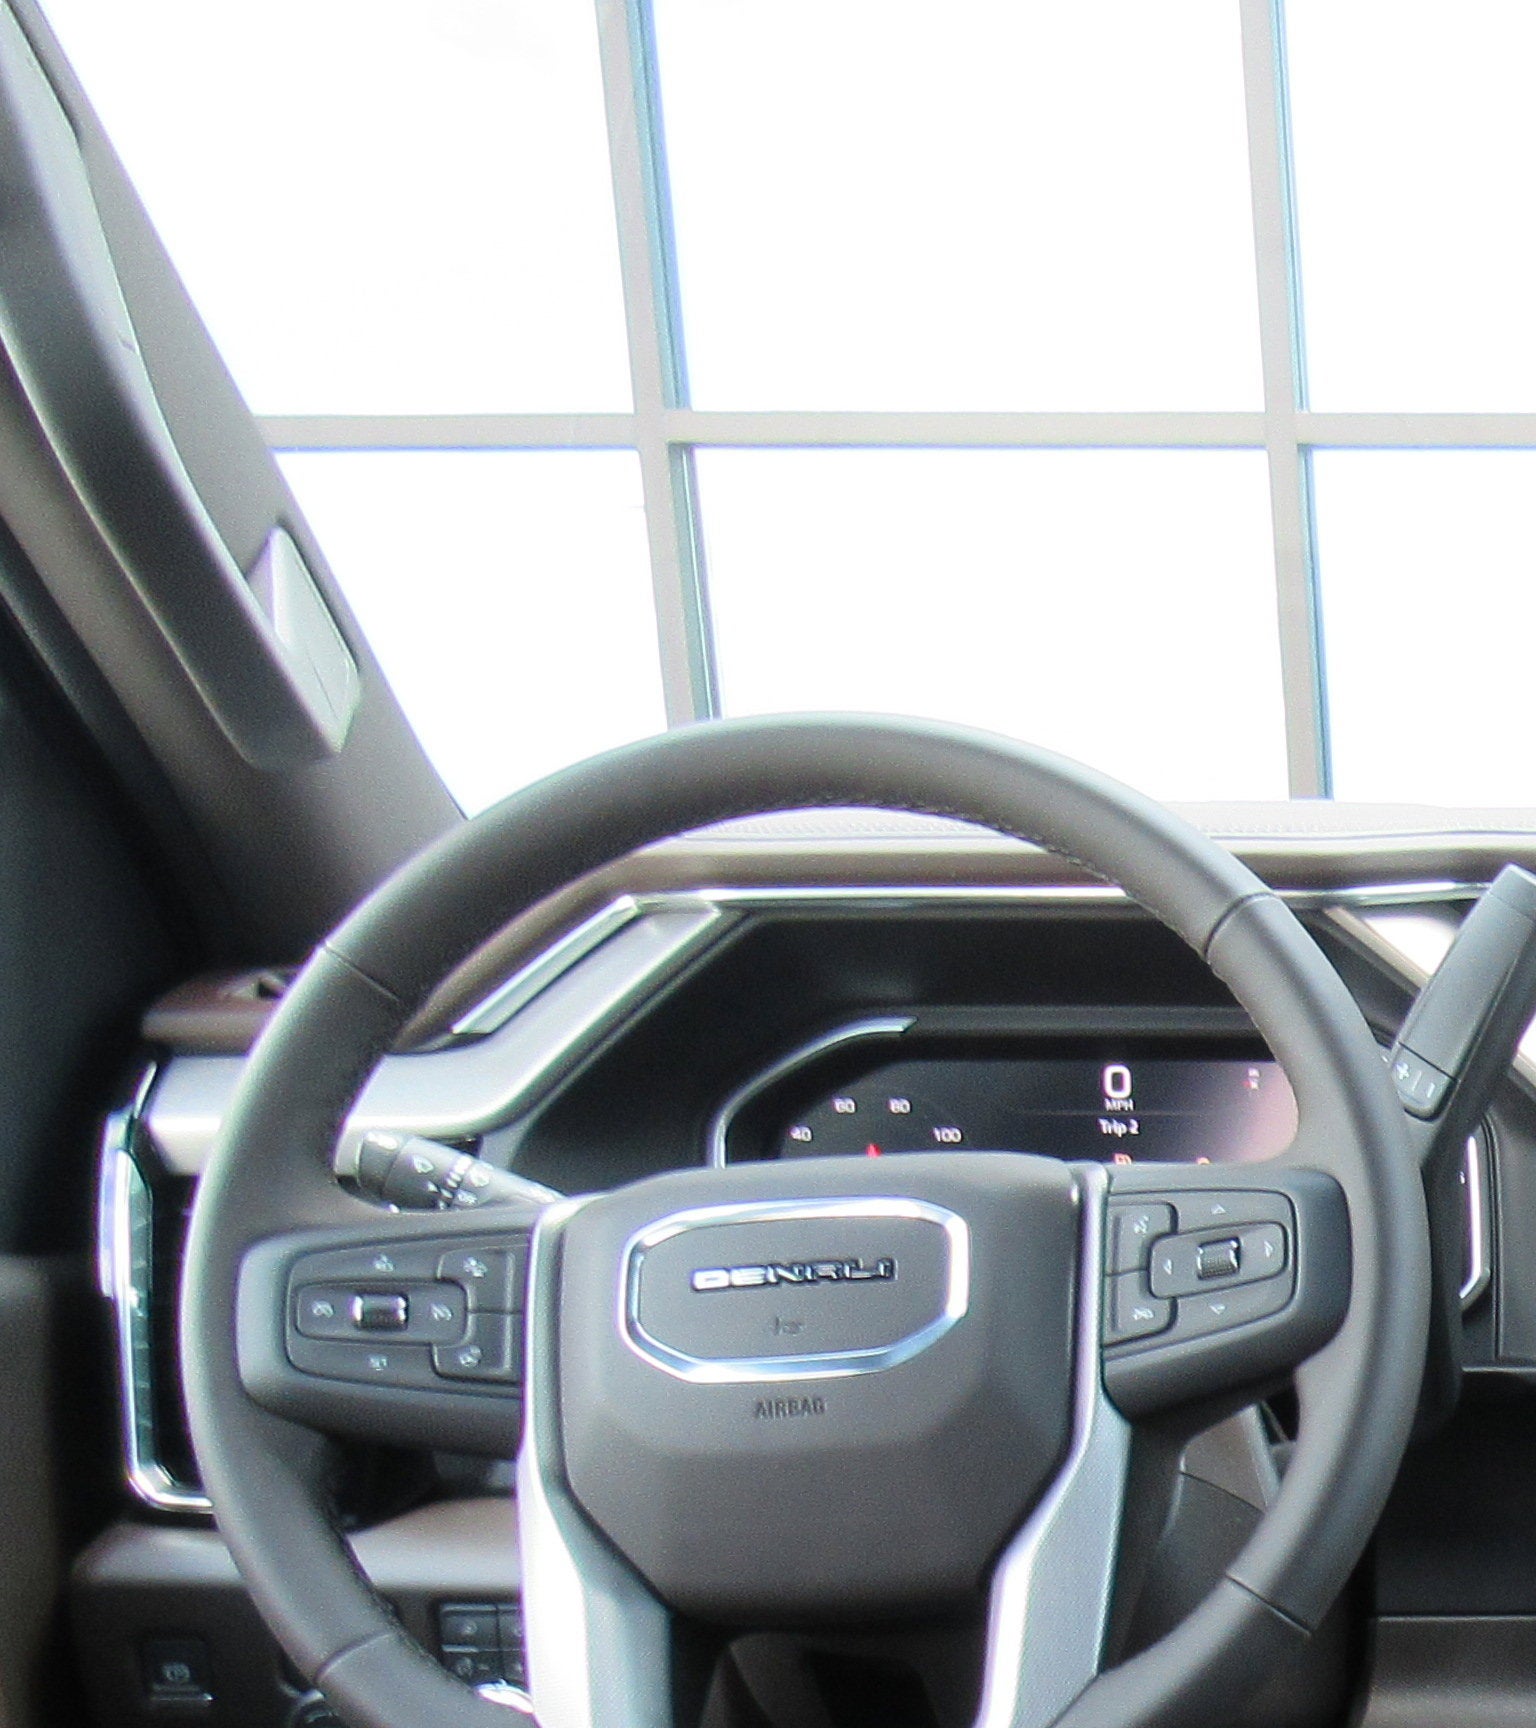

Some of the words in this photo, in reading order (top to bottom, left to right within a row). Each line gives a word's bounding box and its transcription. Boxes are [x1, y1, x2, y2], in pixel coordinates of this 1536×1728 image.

[1104, 1064, 1132, 1098] 0
[1105, 1100, 1134, 1112] MPH
[933, 1126, 963, 1143] 100
[1099, 1118, 1126, 1136] Trip
[1128, 1118, 1139, 1135] 2
[691, 1258, 899, 1292] DENALI
[755, 1397, 826, 1419] AIRBAG
